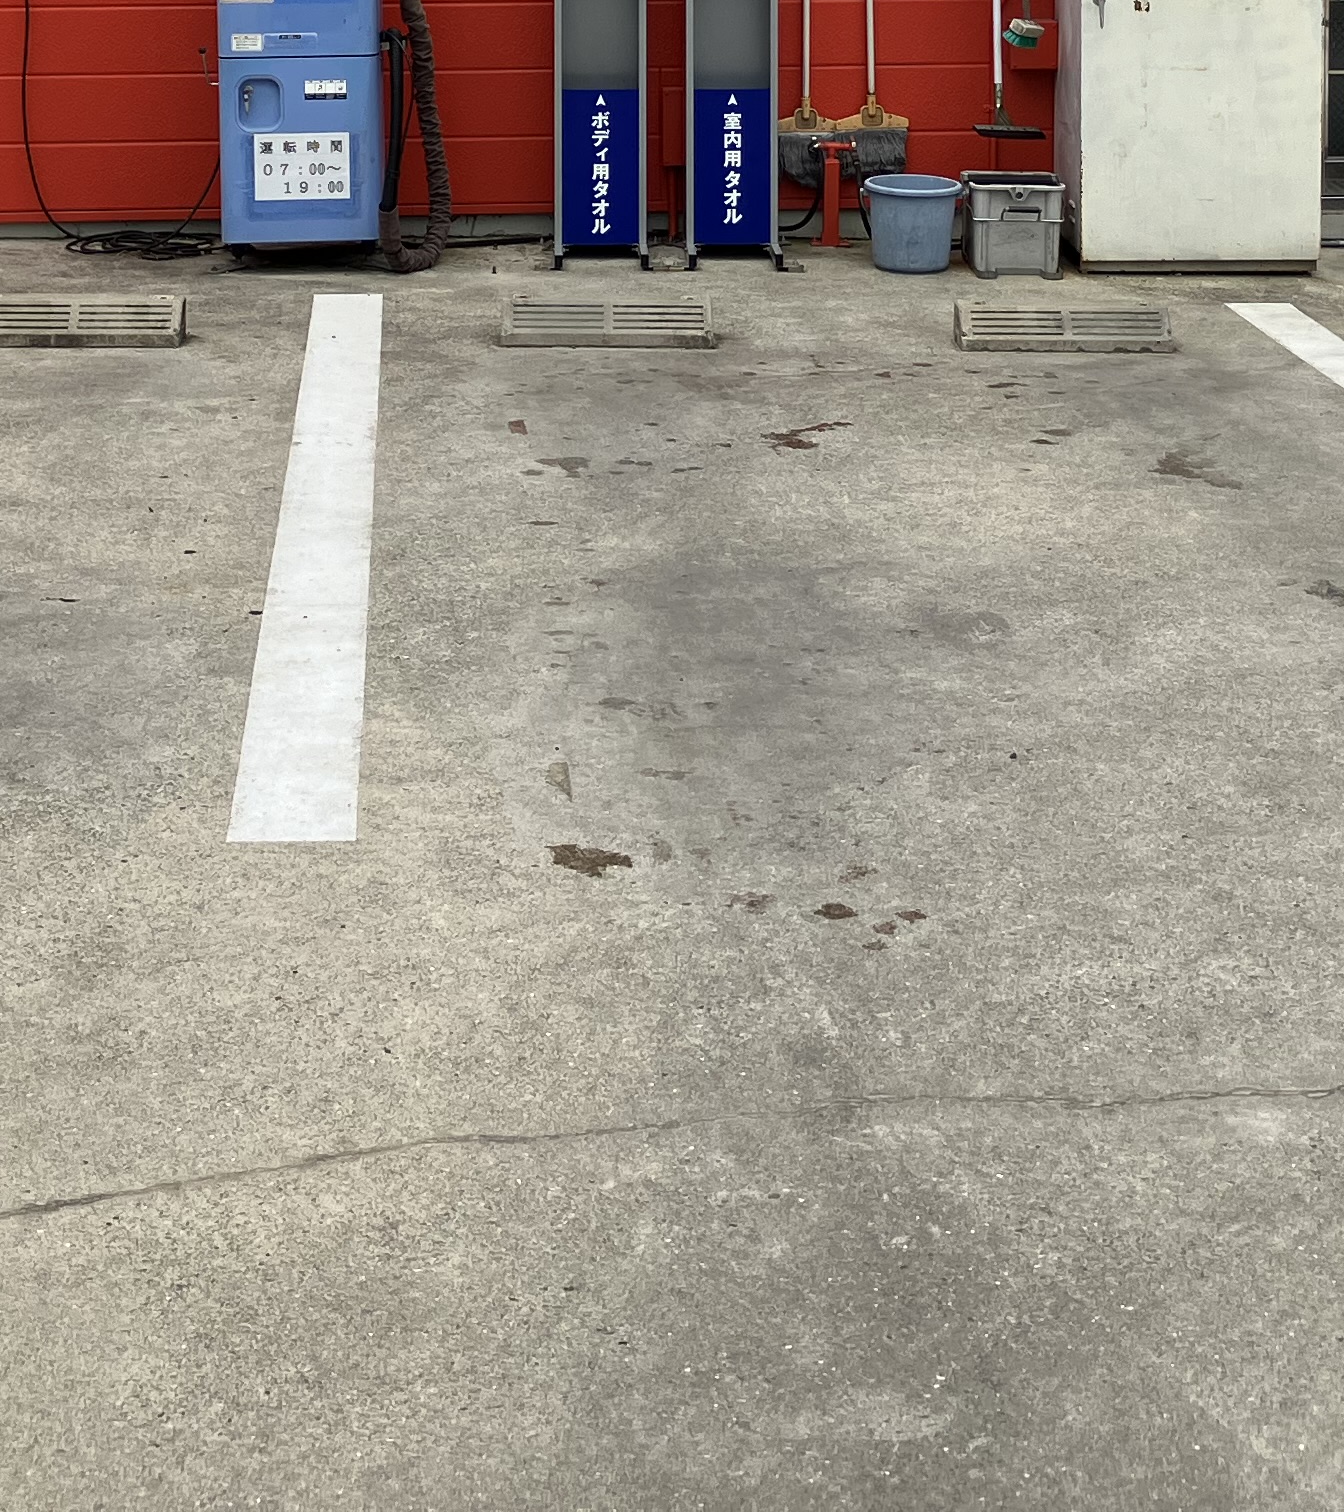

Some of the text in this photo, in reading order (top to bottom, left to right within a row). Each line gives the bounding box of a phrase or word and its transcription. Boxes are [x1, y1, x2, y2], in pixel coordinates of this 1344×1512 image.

[259, 140, 343, 155] 運転時間
[591, 111, 611, 235] ボディ用タオル
[723, 112, 743, 225] 室内用タオル
[284, 180, 344, 194] 19:00
